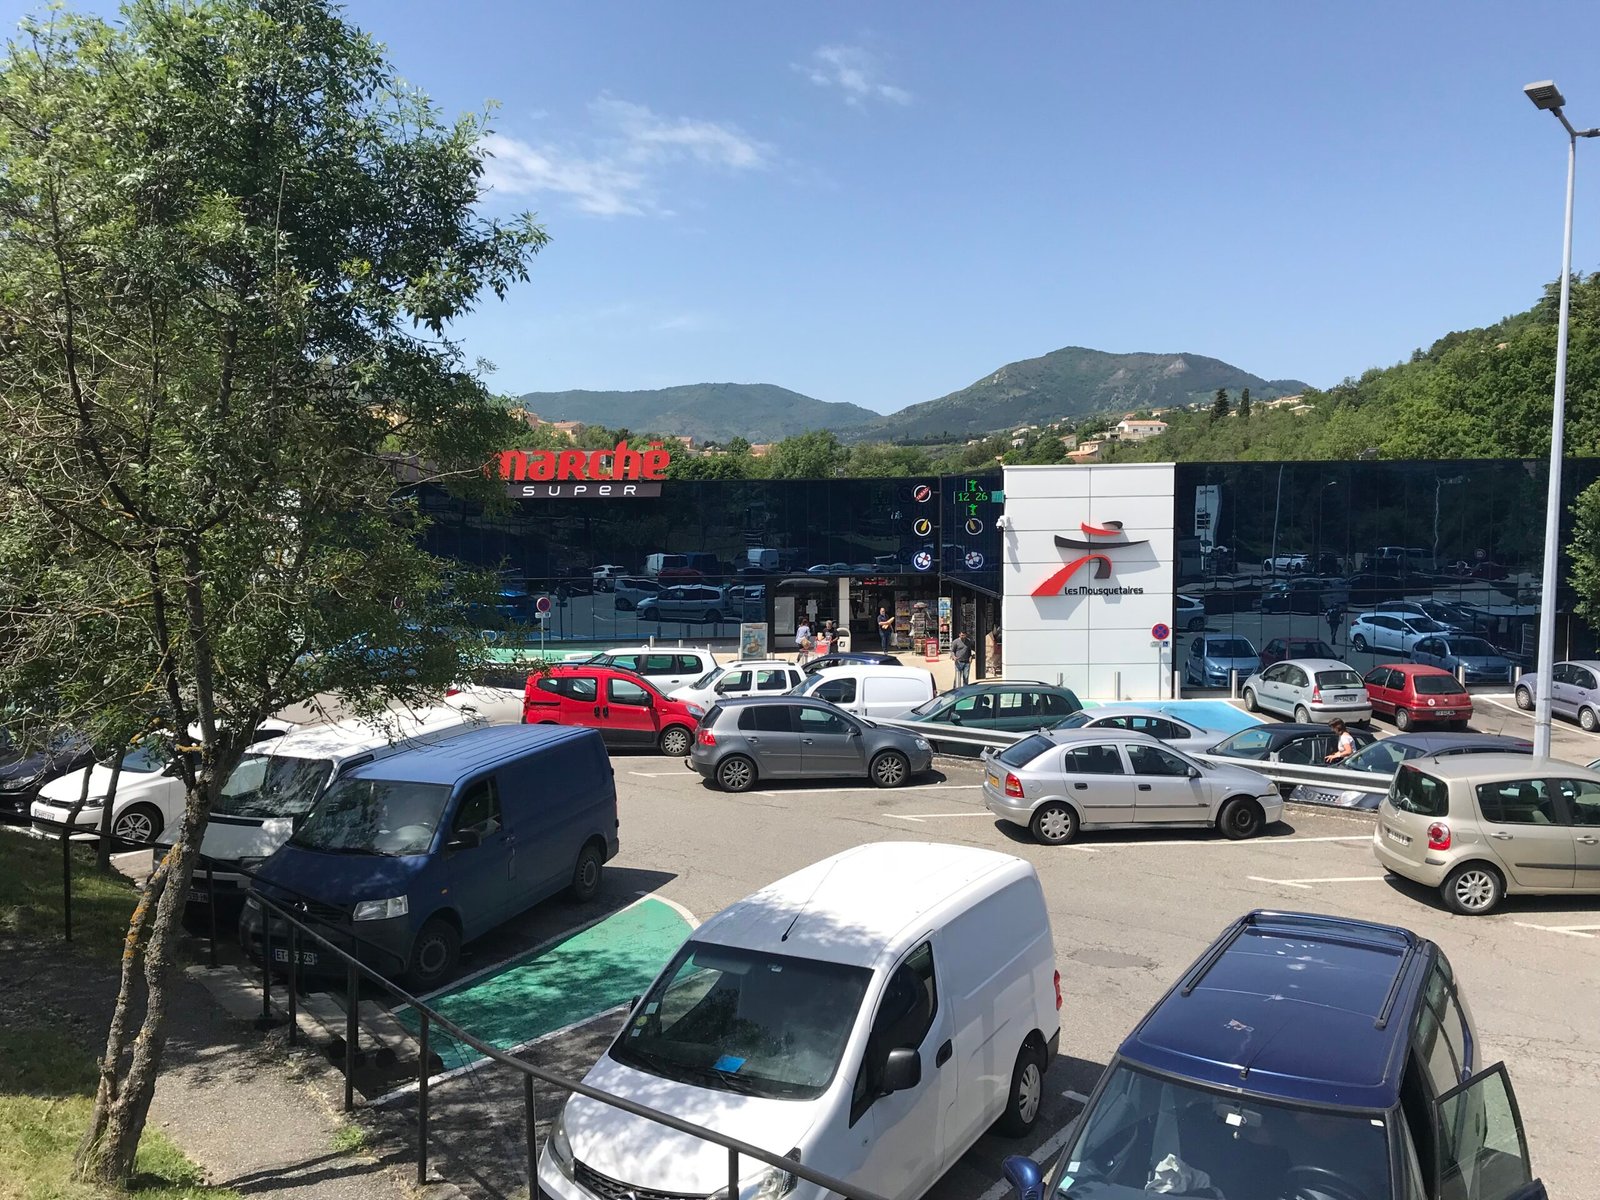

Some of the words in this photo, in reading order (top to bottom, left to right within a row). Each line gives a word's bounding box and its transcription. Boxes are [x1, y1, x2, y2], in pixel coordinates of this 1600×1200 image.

[958, 492, 970, 502] 12
[975, 492, 988, 501] 26
[1064, 587, 1078, 595] les
[1079, 586, 1144, 596] Mousquetaires
